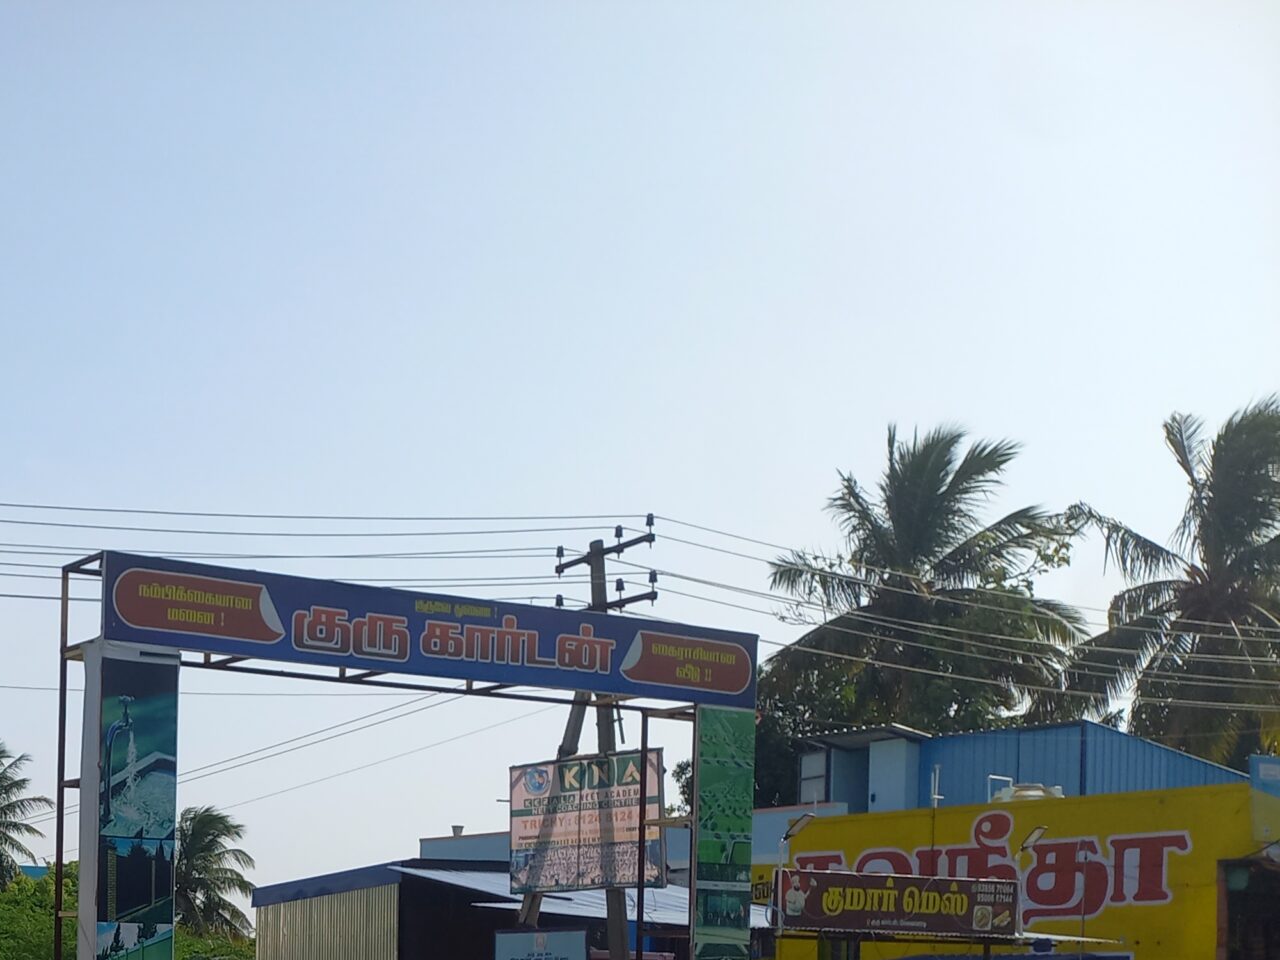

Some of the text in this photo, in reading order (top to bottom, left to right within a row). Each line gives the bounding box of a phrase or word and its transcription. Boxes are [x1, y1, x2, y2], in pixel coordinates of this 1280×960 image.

[292, 604, 617, 676] குரு கார்டன்
[562, 758, 641, 790] KNA
[604, 787, 641, 800] ACADEM
[822, 877, 969, 917] குமார் மெஸ்
